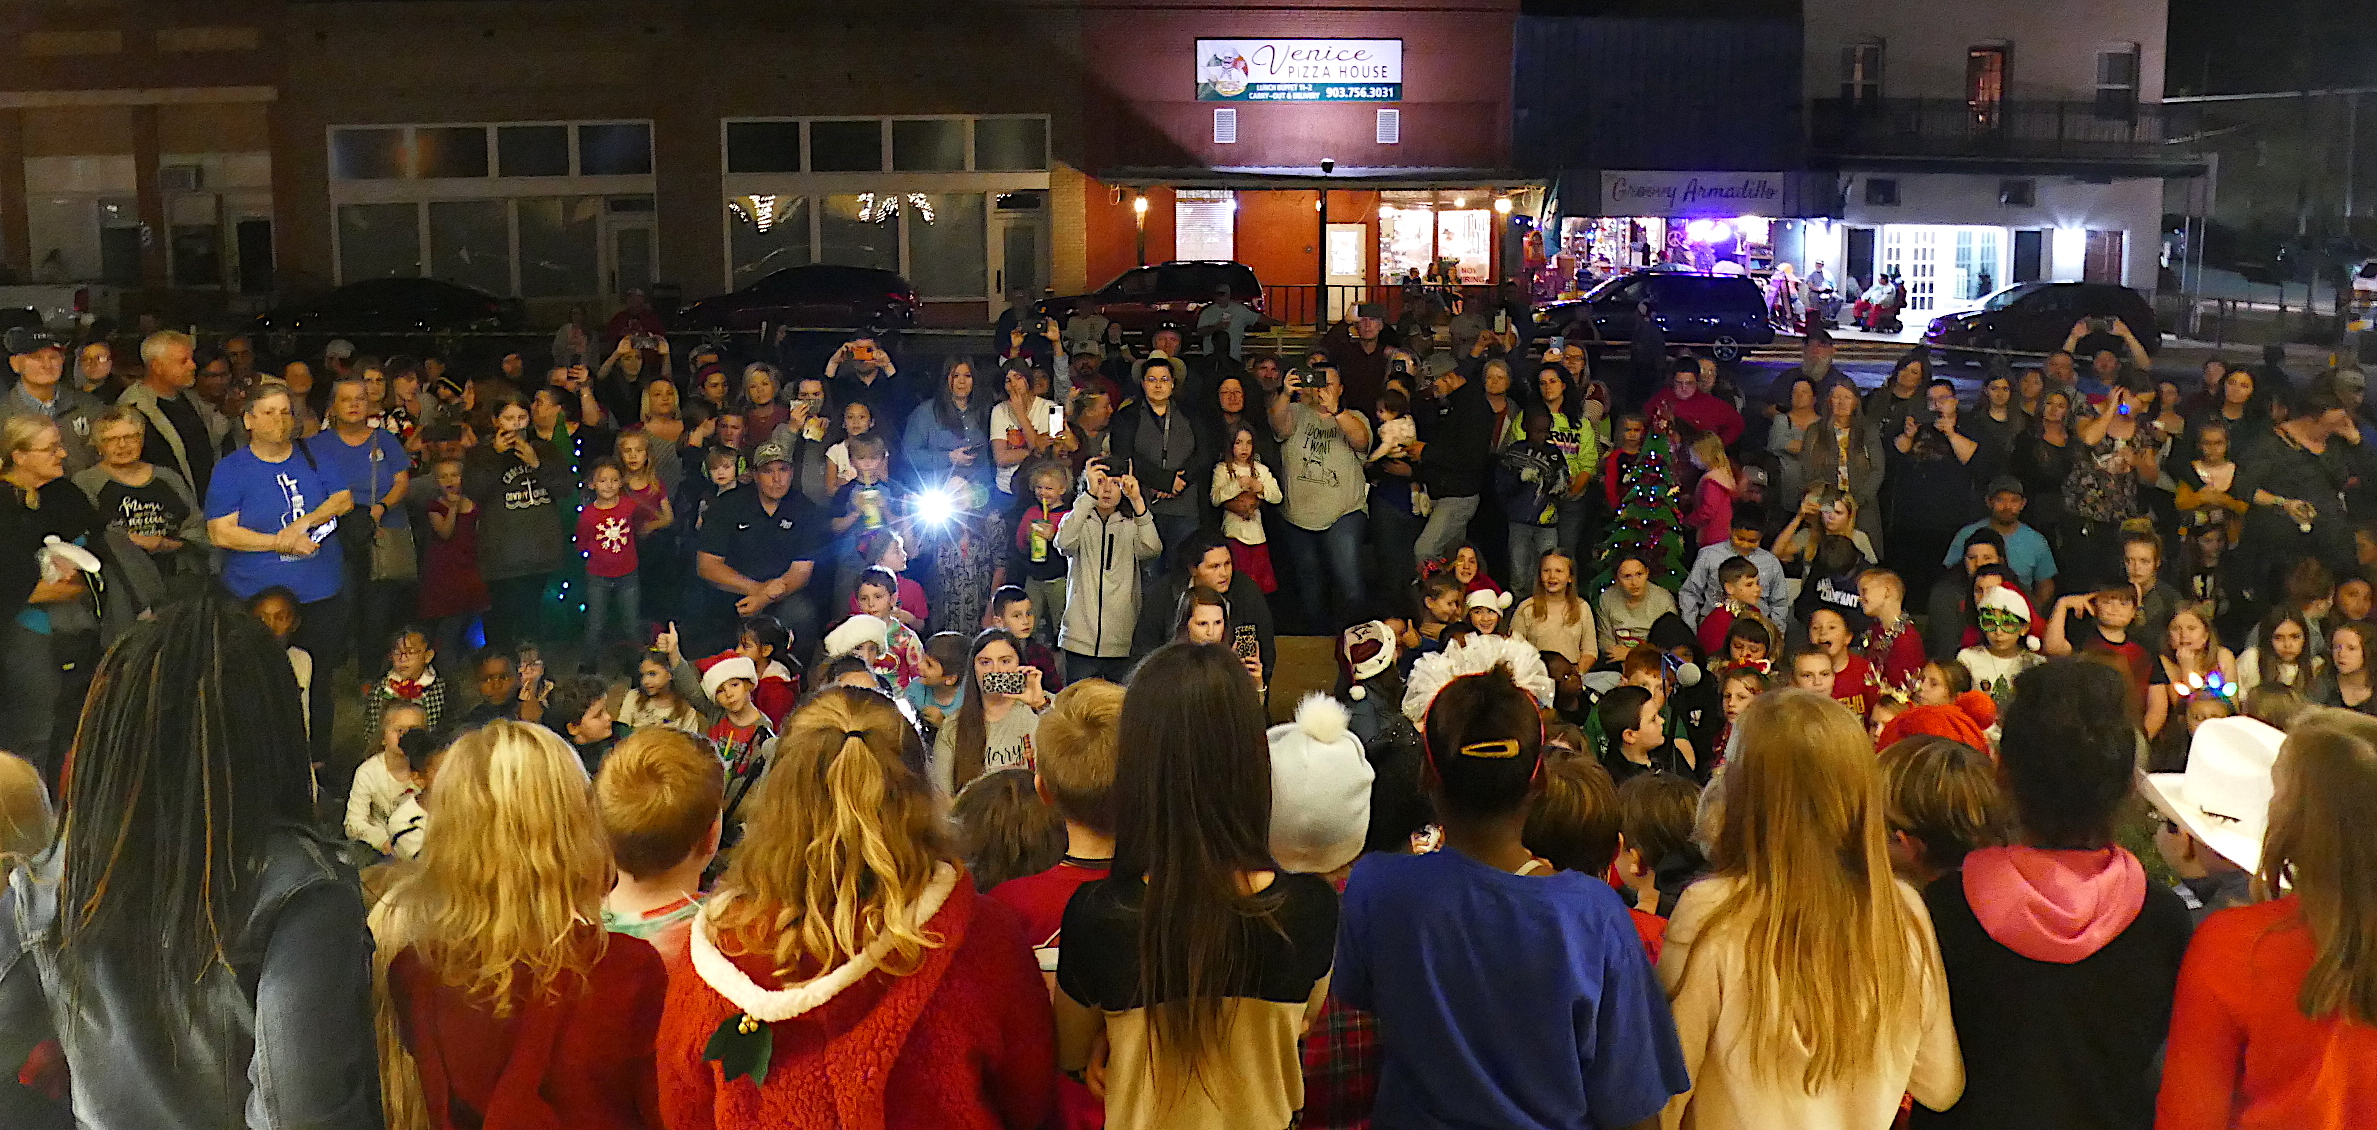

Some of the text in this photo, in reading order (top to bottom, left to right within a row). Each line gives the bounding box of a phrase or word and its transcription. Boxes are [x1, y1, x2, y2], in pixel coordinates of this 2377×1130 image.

[1252, 45, 1373, 75] Venice
[1288, 66, 1388, 78] PIZZA HOUSE
[1326, 87, 1394, 98] 903.756.3031
[1612, 177, 1776, 208] Groovy Armadillo
